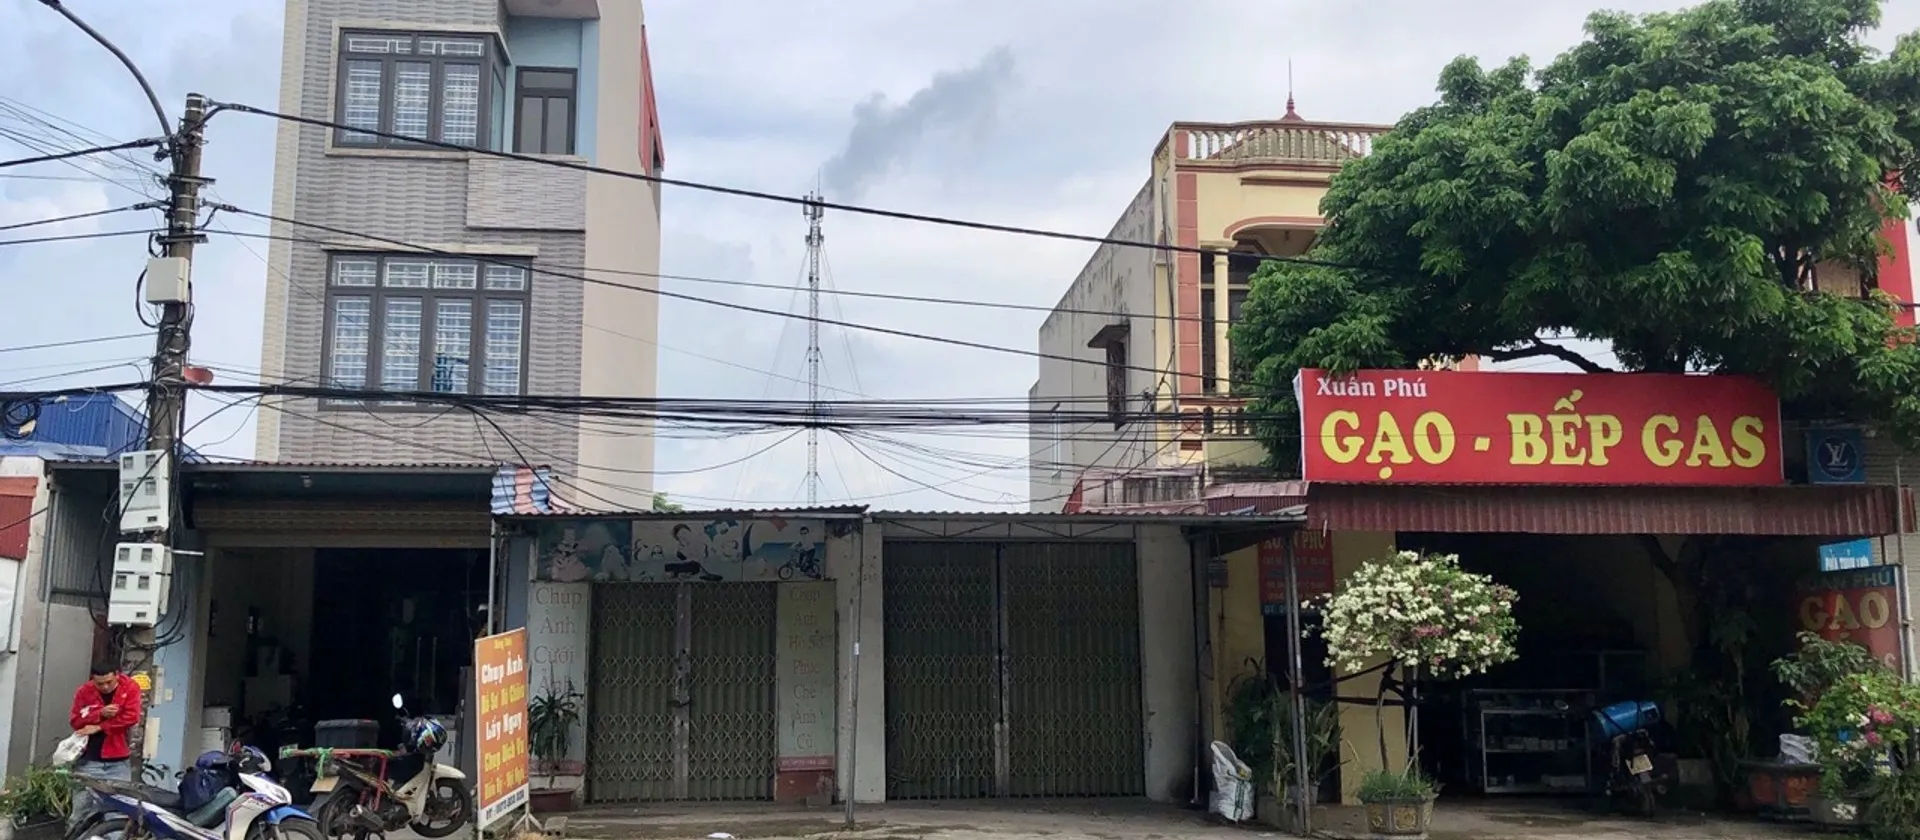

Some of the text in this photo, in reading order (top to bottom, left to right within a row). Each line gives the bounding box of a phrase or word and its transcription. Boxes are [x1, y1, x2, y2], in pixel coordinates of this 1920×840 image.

[1383, 377, 1427, 397] Phú
[1320, 389, 1767, 479] GẠO - BẾP GAS
[1852, 565, 1891, 587] PHÚ
[535, 586, 582, 609] Chụp
[539, 608, 576, 634] Ảnh
[534, 644, 575, 664] Cưới
